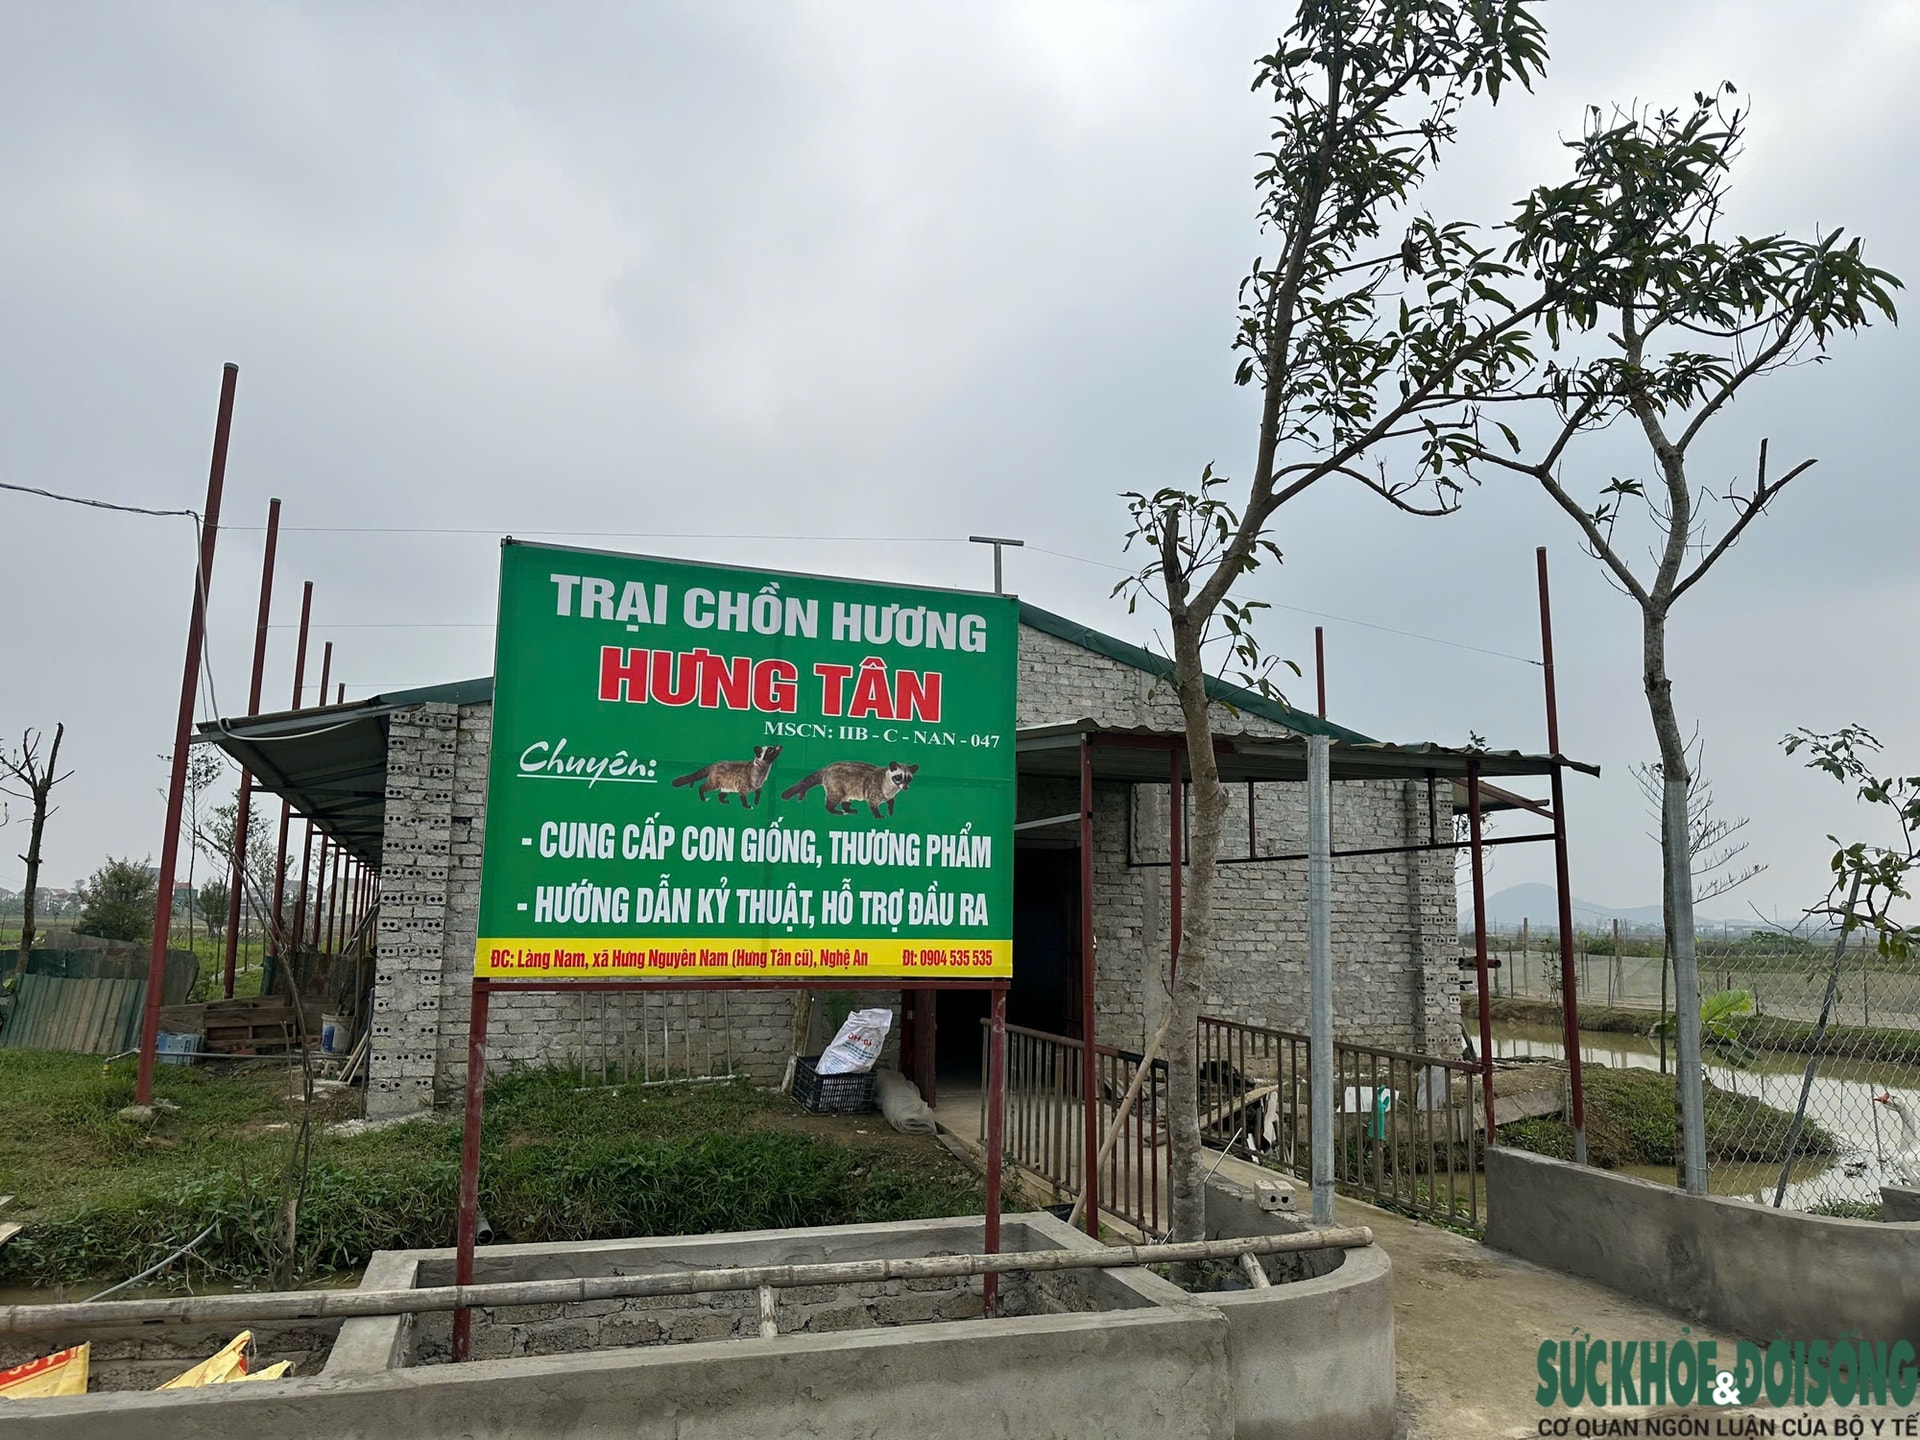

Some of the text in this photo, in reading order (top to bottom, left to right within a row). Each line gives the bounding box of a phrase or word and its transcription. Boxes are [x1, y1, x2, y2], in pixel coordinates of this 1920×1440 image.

[550, 574, 987, 652] TRẠI CHỒN HƯƠNG
[599, 646, 942, 723] HƯNG TÂN
[763, 721, 833, 738] MSCN:
[839, 726, 868, 740] IIB
[884, 729, 897, 742] C
[914, 731, 955, 746] NAN
[971, 734, 1000, 748] 047
[519, 738, 657, 789] Chuyên:
[539, 821, 615, 859] CUNG
[622, 812, 675, 860] CẤP
[682, 826, 735, 862] CON
[741, 817, 822, 868] GIỐNG,
[829, 827, 920, 866] THƯƠNG
[926, 822, 991, 868] PHẨM
[534, 878, 629, 924] HƯỚNG
[635, 874, 690, 924] DẪN
[697, 877, 731, 924] KỶ
[736, 883, 815, 932] THUẬT,
[822, 877, 855, 925] HỖ
[859, 888, 904, 932] TRỢ
[908, 881, 954, 926] ĐẦU
[959, 892, 988, 926] RA
[490, 948, 868, 969] ĐC: Làng Nam, xã Hưng Nguyên Nam (Hưng Tân cũ), Nghệ An
[902, 949, 992, 966] Đt: 0904 535 535
